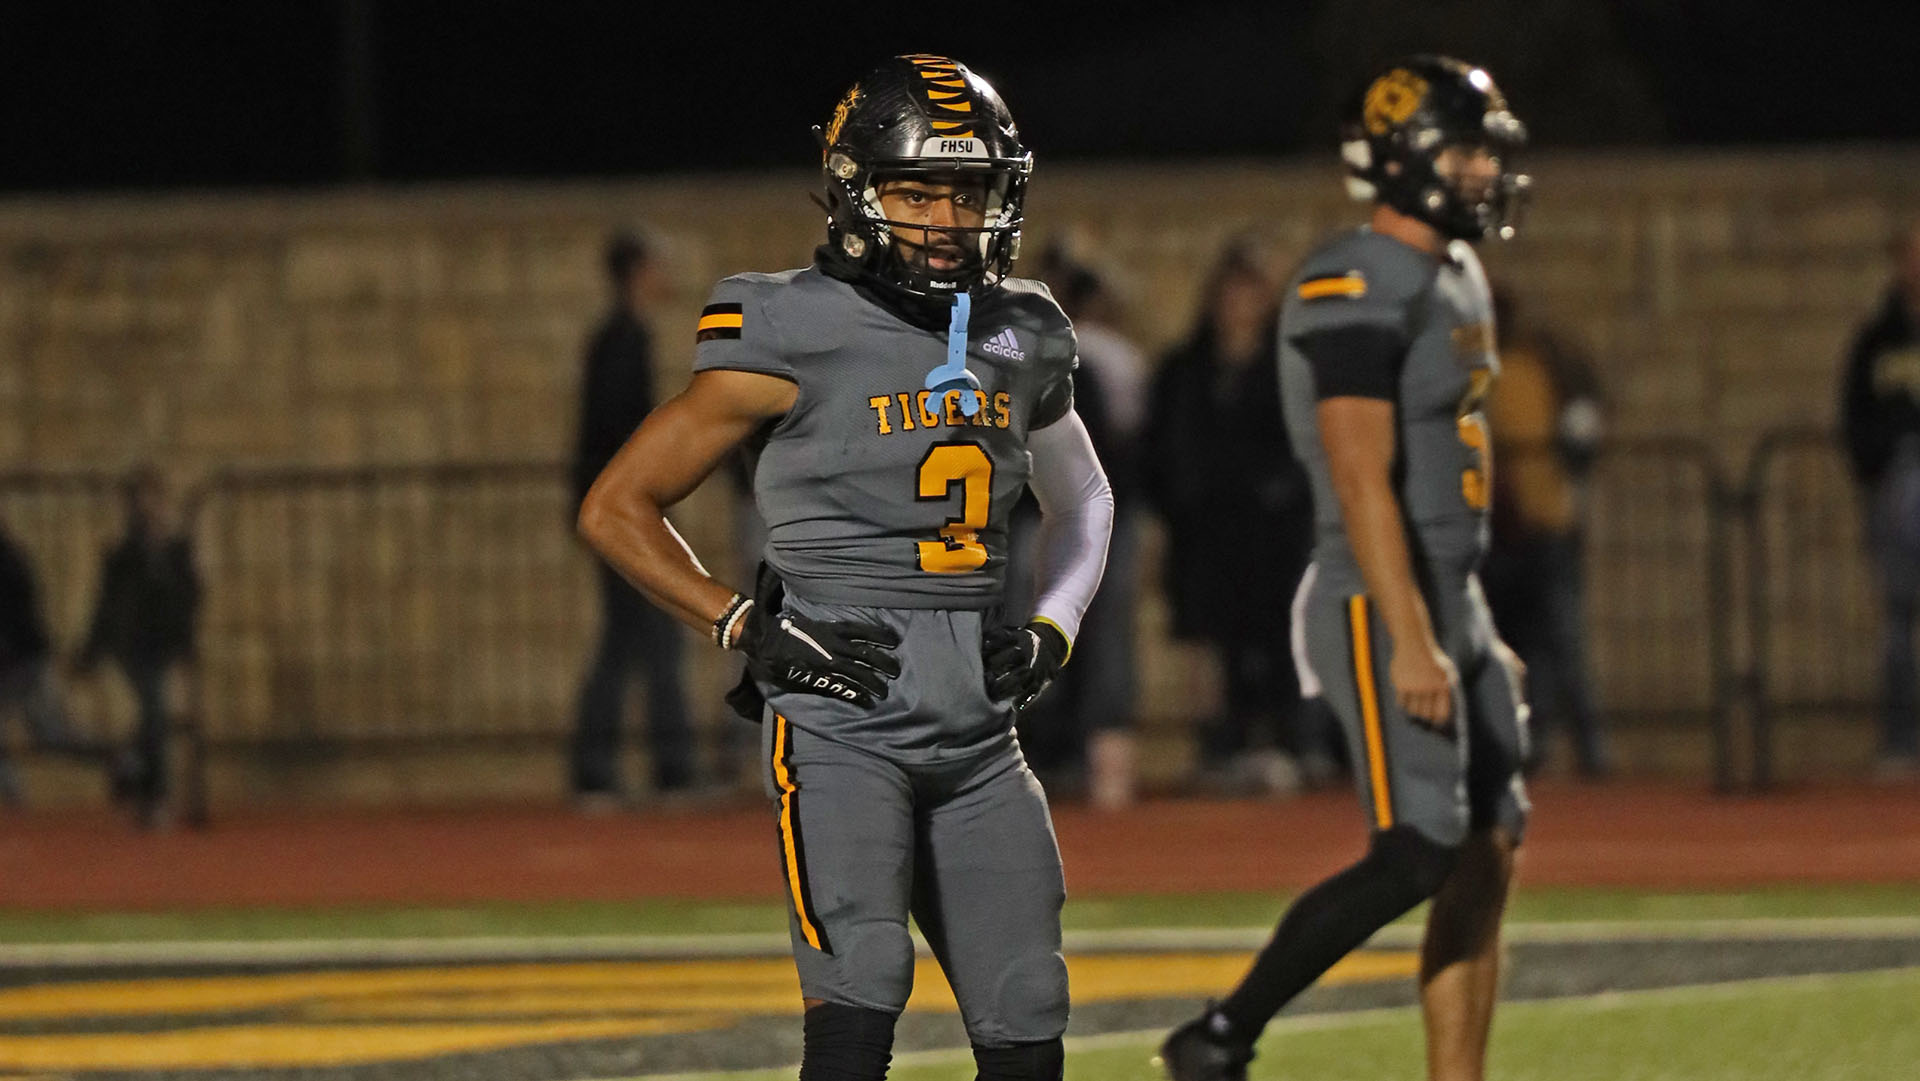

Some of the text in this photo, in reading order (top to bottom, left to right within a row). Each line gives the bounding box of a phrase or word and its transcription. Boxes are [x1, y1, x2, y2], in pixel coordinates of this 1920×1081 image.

[940, 140, 973, 153] FHSU
[982, 342, 1026, 362] adidas
[869, 388, 1012, 437] TIGERS
[914, 441, 995, 573] 3
